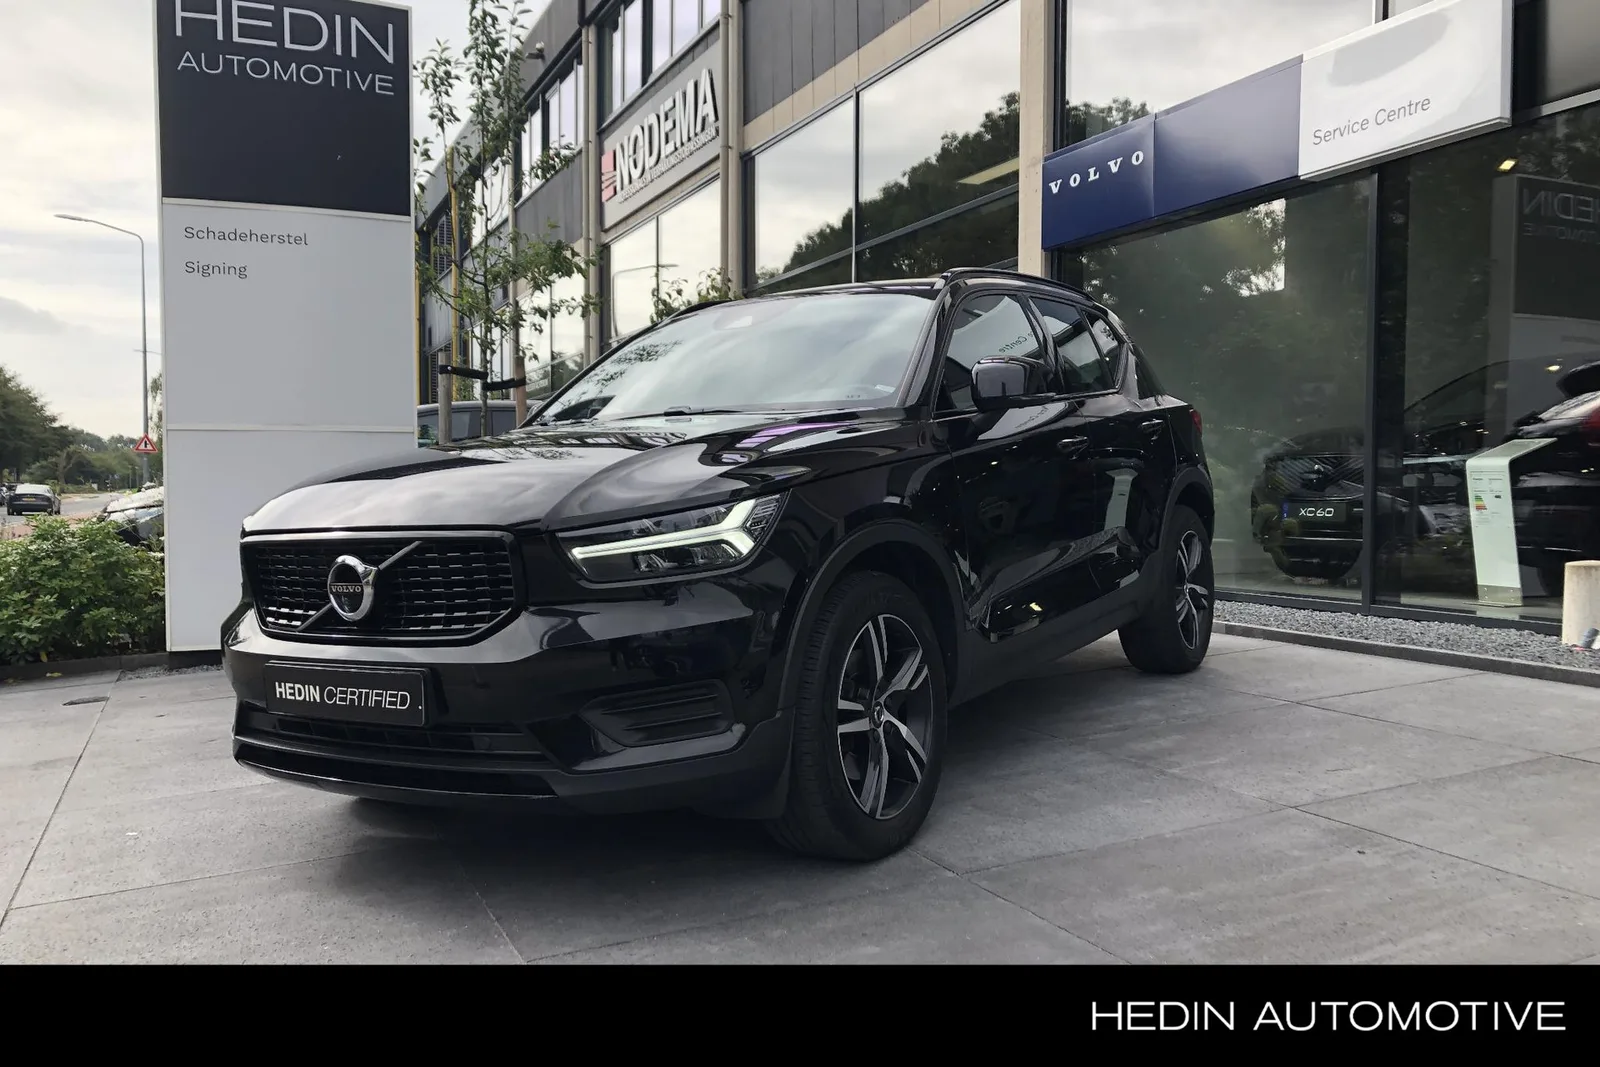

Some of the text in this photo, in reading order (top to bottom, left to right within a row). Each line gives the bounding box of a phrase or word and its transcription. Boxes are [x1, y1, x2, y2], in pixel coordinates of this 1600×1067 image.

[175, 0, 394, 64] HEDIN
[177, 51, 394, 96] AUTOMOTIVE
[616, 67, 719, 193] NODEMA
[1312, 97, 1431, 146] Service Centre
[1048, 150, 1144, 195] VOLVO
[184, 226, 309, 246] Schadeherstel
[184, 260, 248, 279] Signing
[1299, 507, 1335, 517] XC60
[331, 585, 362, 593] VOLVO
[275, 681, 411, 710] HEDIN CERTIFIED
